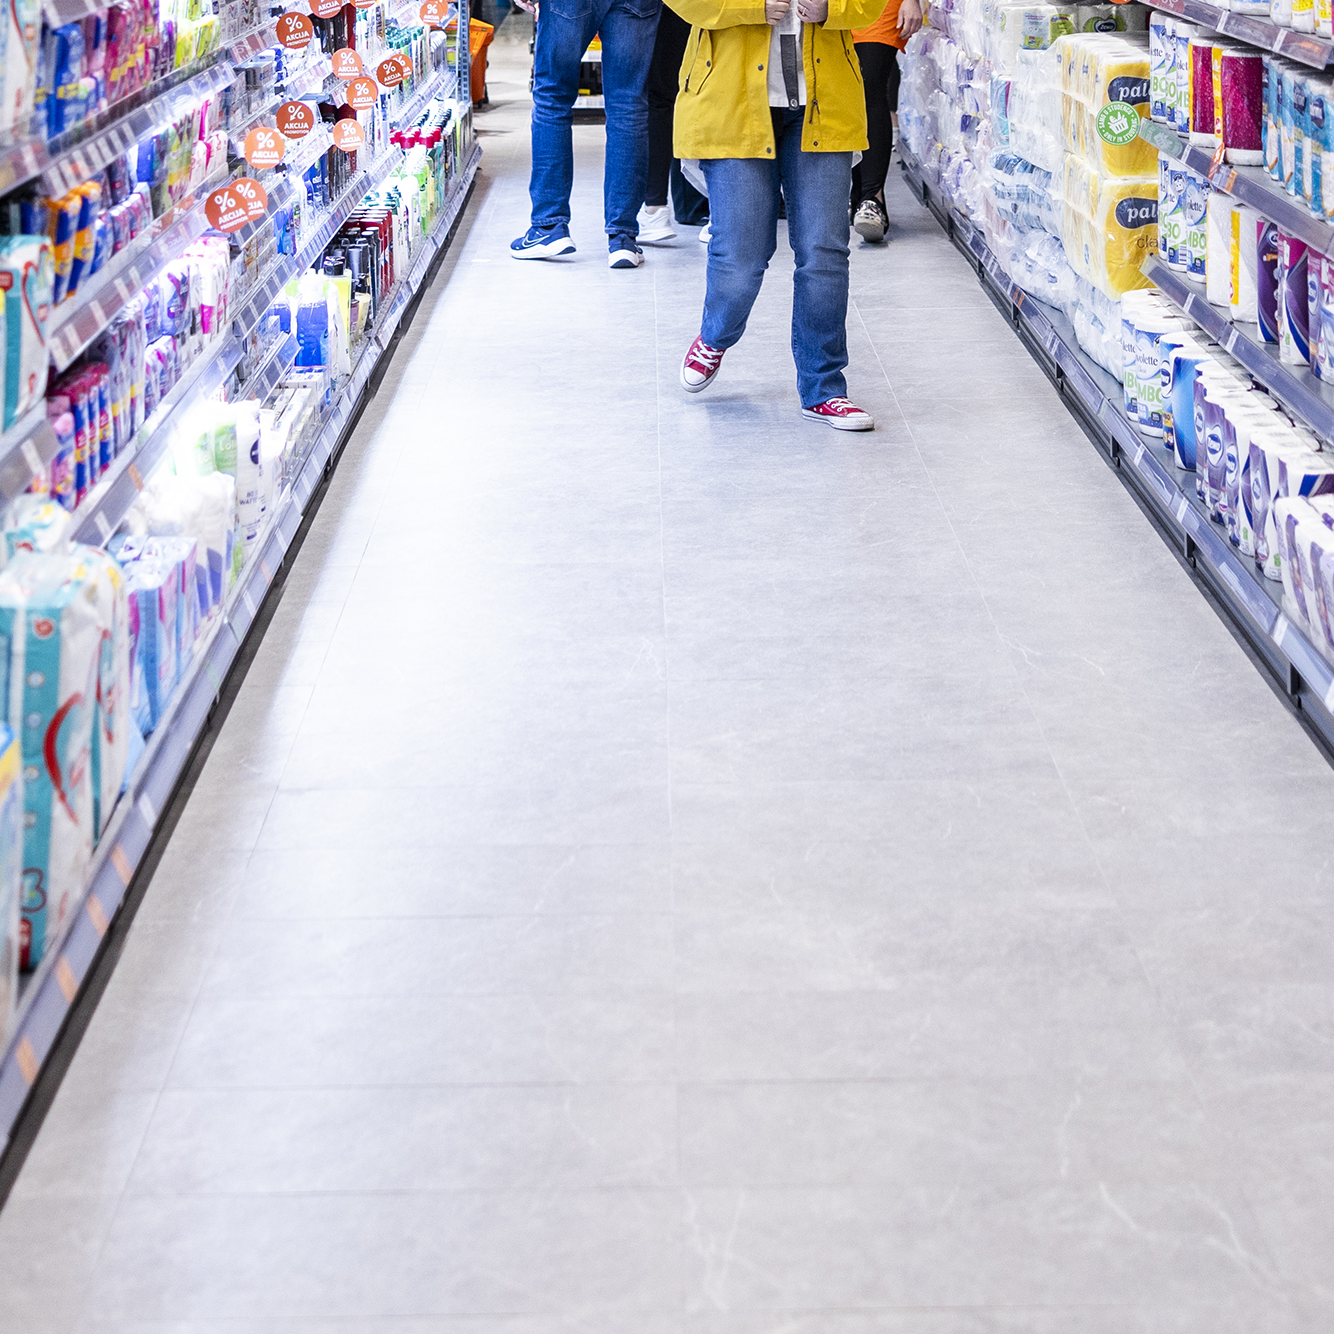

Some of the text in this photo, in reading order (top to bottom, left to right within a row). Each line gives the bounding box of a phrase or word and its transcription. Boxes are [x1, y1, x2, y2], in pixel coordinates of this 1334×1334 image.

[318, 0, 340, 12] AKCIJA
[286, 31, 310, 42] AKCIJA
[383, 73, 402, 82] AKCIJA
[1118, 82, 1150, 102] pal
[352, 96, 374, 104] AKCIJA
[339, 136, 362, 145] AKCIJA
[251, 151, 280, 159] AKCIJA
[218, 209, 246, 226] AKCIJA
[1127, 204, 1158, 223] pal
[1137, 382, 1163, 404] MBO
